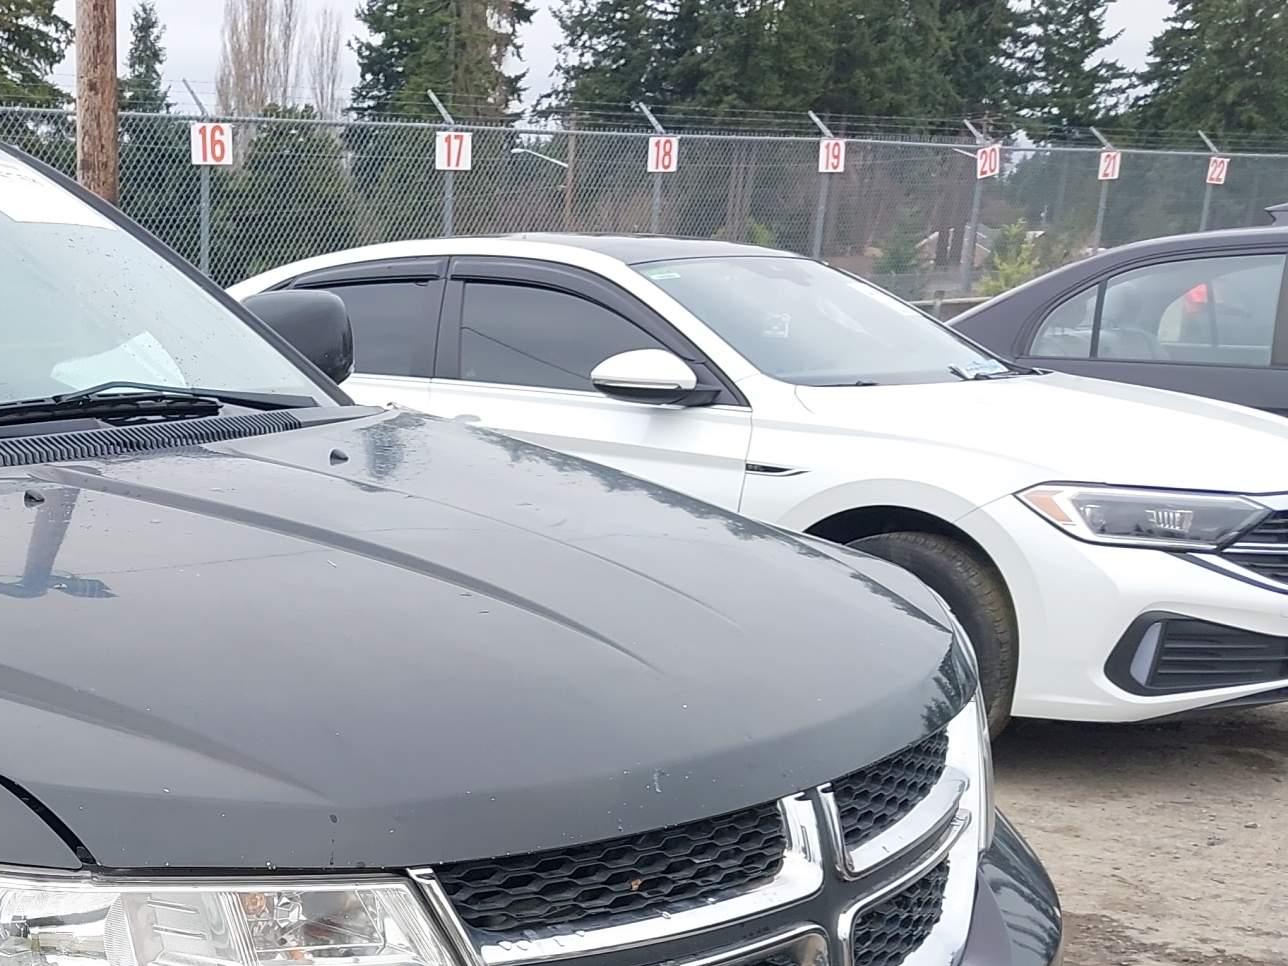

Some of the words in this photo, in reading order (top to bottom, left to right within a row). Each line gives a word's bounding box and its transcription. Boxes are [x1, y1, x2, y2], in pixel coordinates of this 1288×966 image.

[198, 125, 226, 163] 16
[443, 134, 464, 168] 17
[654, 138, 673, 170] 18
[824, 142, 841, 170] 19
[979, 149, 997, 177] 20
[1102, 153, 1118, 178] 21
[1209, 159, 1227, 183] 22
